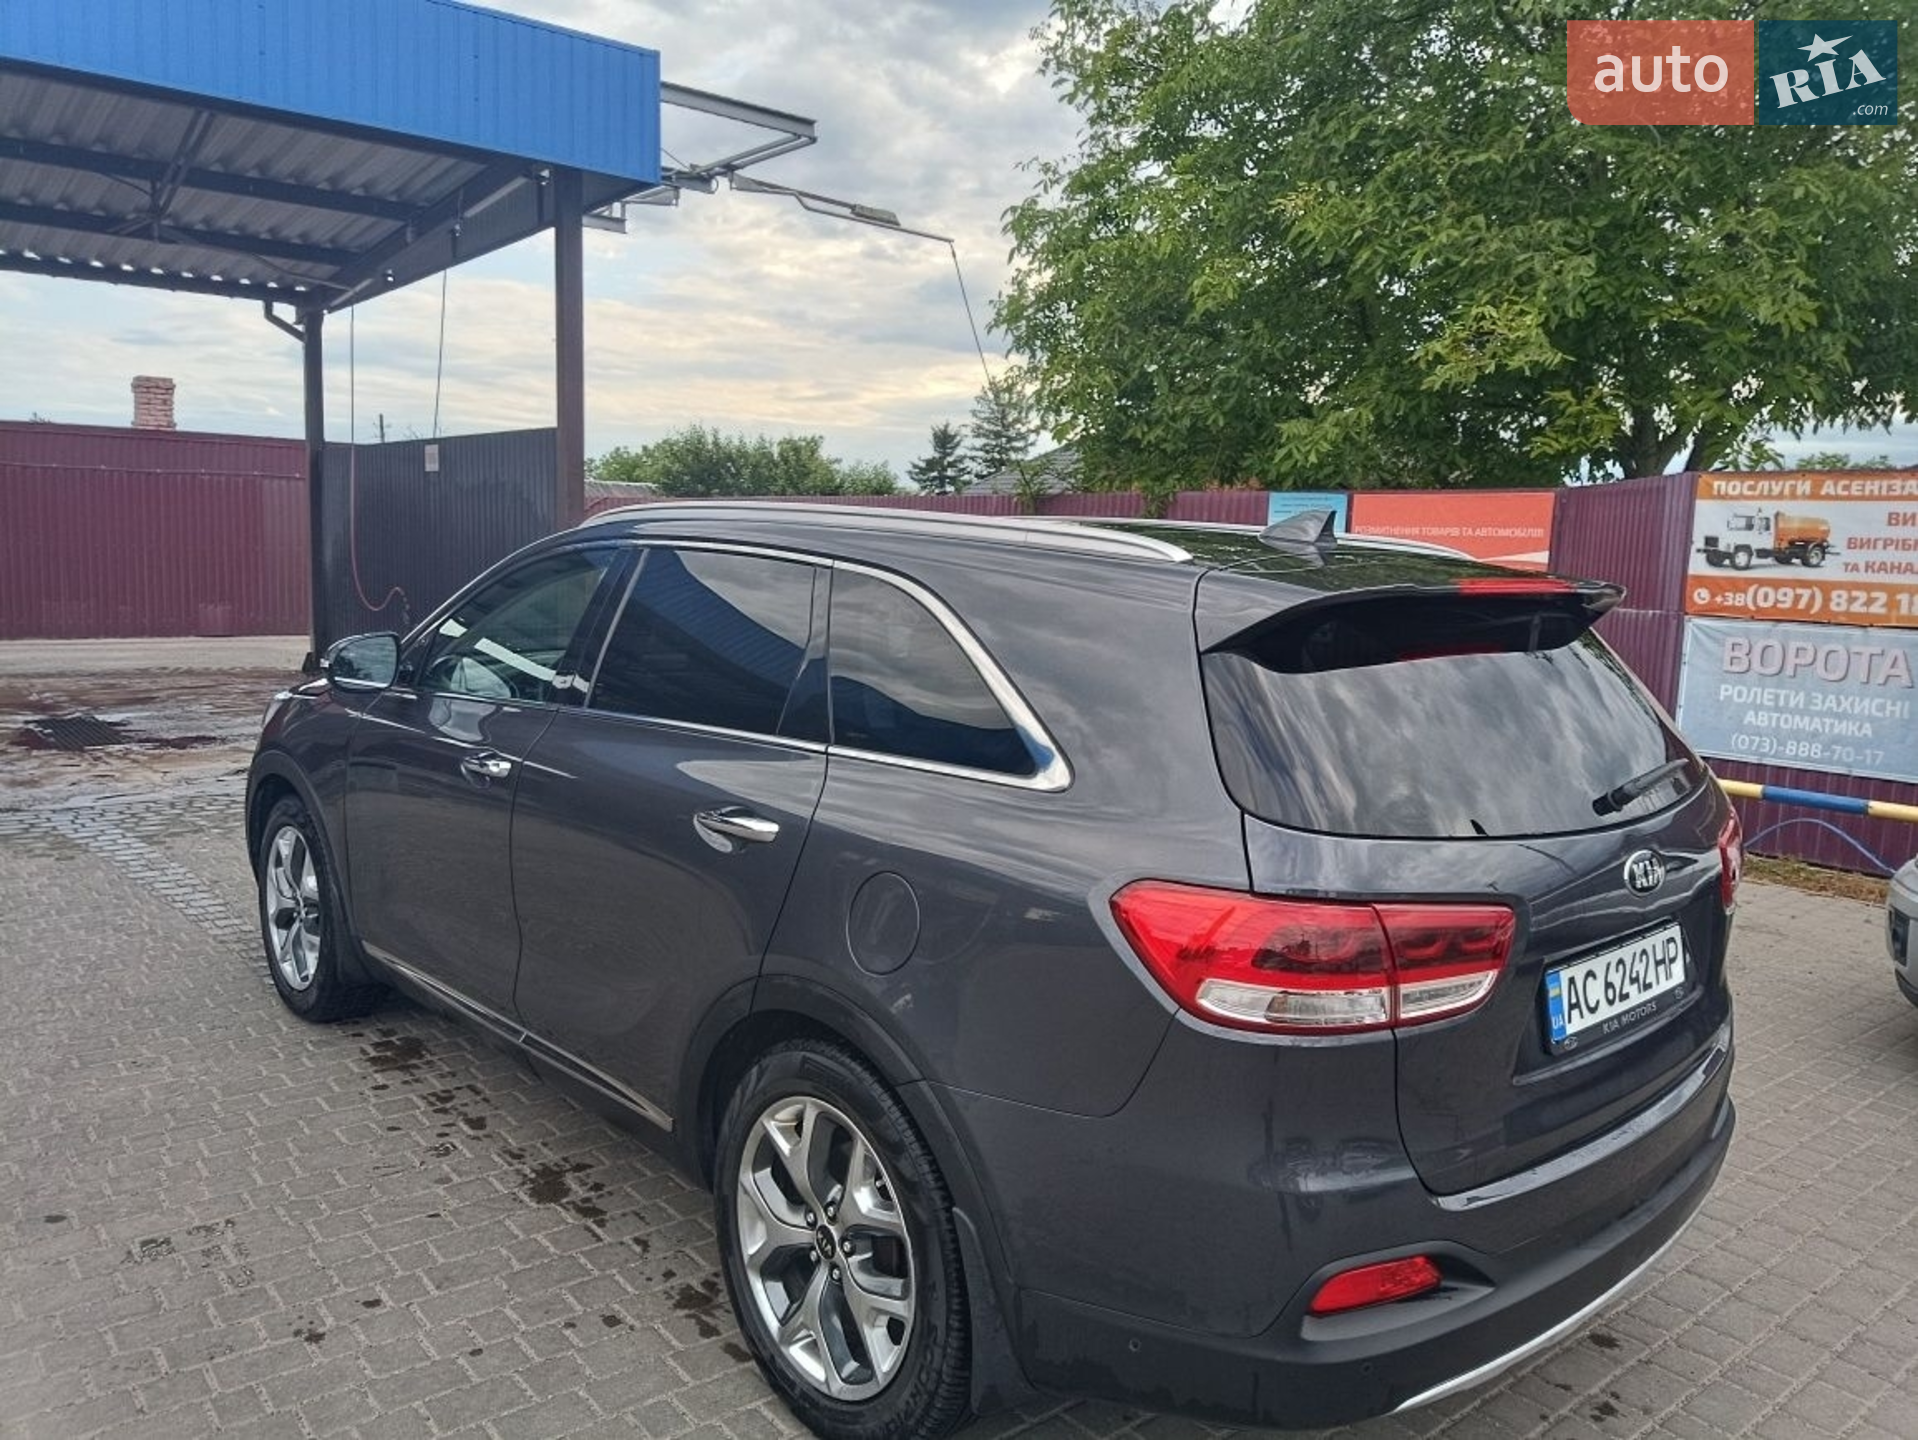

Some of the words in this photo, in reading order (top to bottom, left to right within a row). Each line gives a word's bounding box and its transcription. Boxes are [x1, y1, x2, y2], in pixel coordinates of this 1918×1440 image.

[1712, 480, 1811, 496] ПОСЛУГИ
[1829, 589, 1888, 614] 822
[1722, 635, 1914, 689] ВОРОТА
[1719, 684, 1805, 709] РОЛЕТИ
[1810, 692, 1911, 720] ЗАХИСНІ
[1743, 709, 1873, 738] АВТОМАТИКА
[1632, 856, 1664, 889] KIA
[1567, 969, 1601, 1025] AC
[1603, 948, 1654, 1007] 6242
[1652, 936, 1679, 986] HP
[1551, 1014, 1566, 1029] UA
[1602, 1018, 1619, 1035] KIA
[1621, 1003, 1657, 1026] MOTORS
